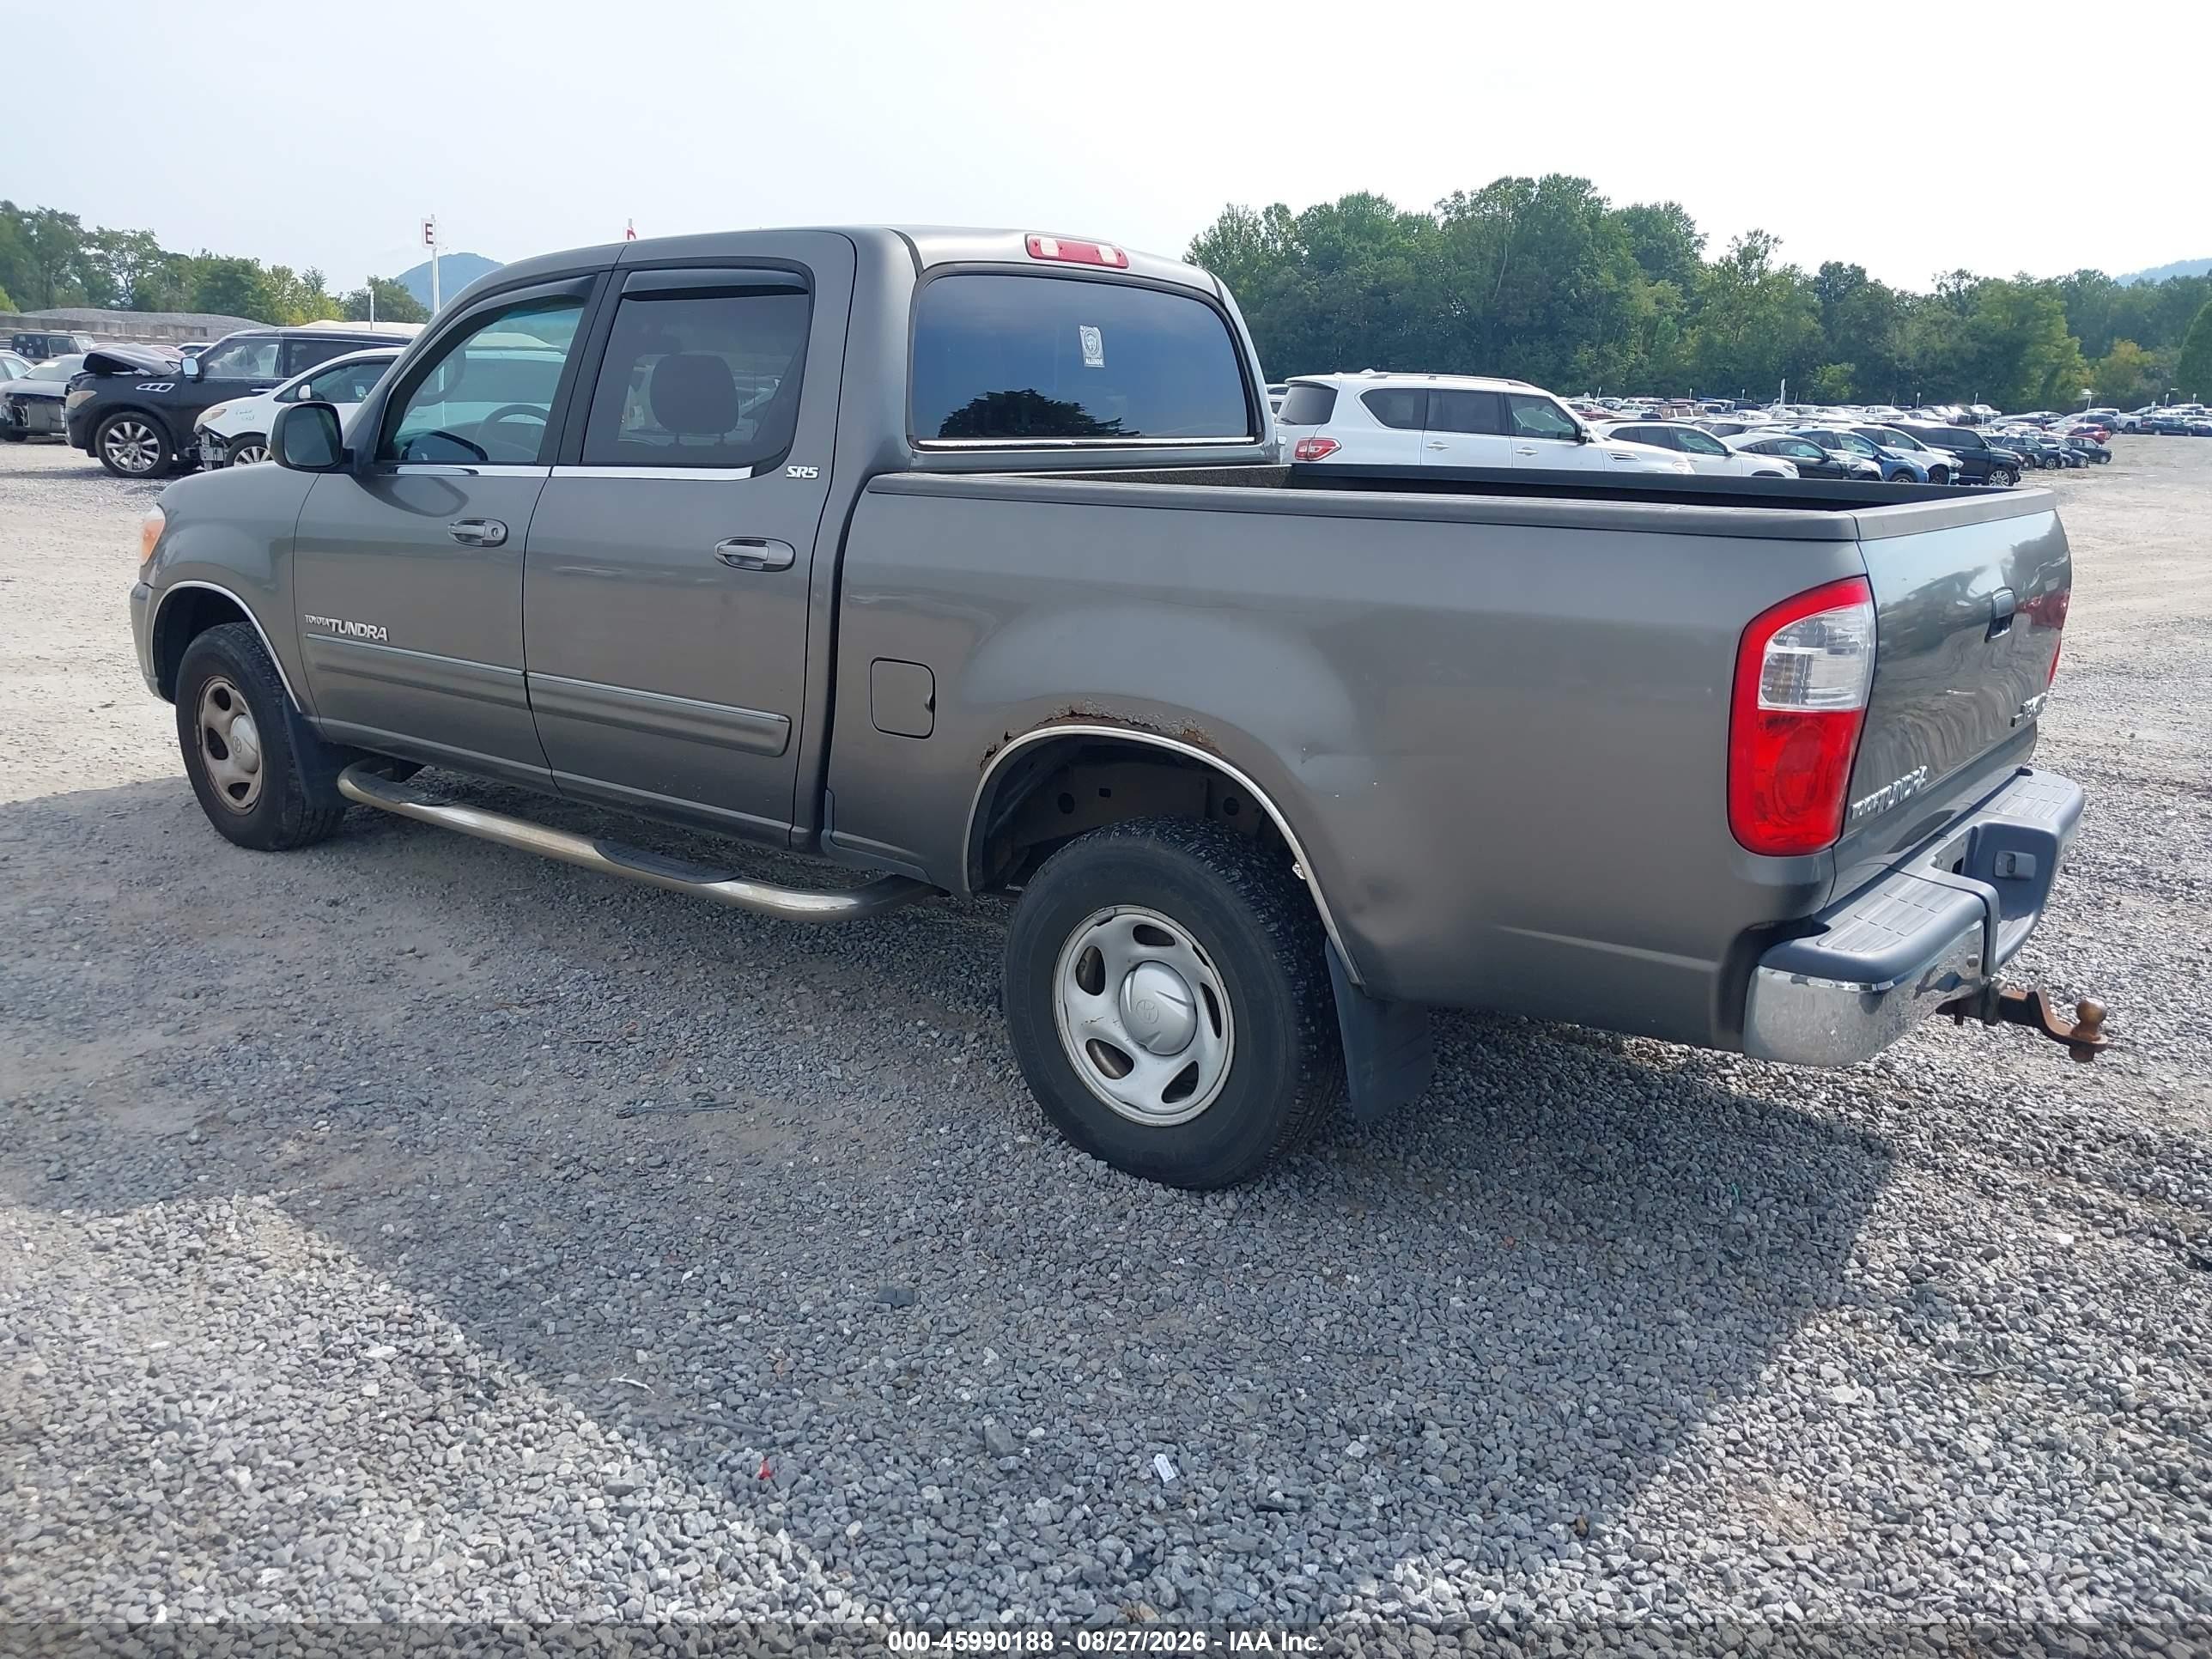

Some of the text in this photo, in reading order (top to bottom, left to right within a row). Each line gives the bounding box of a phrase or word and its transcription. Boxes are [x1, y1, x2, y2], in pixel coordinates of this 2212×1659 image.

[425, 222, 434, 245] E
[786, 465, 819, 479] SR5
[304, 614, 389, 642] TOYOTA TUNDRA
